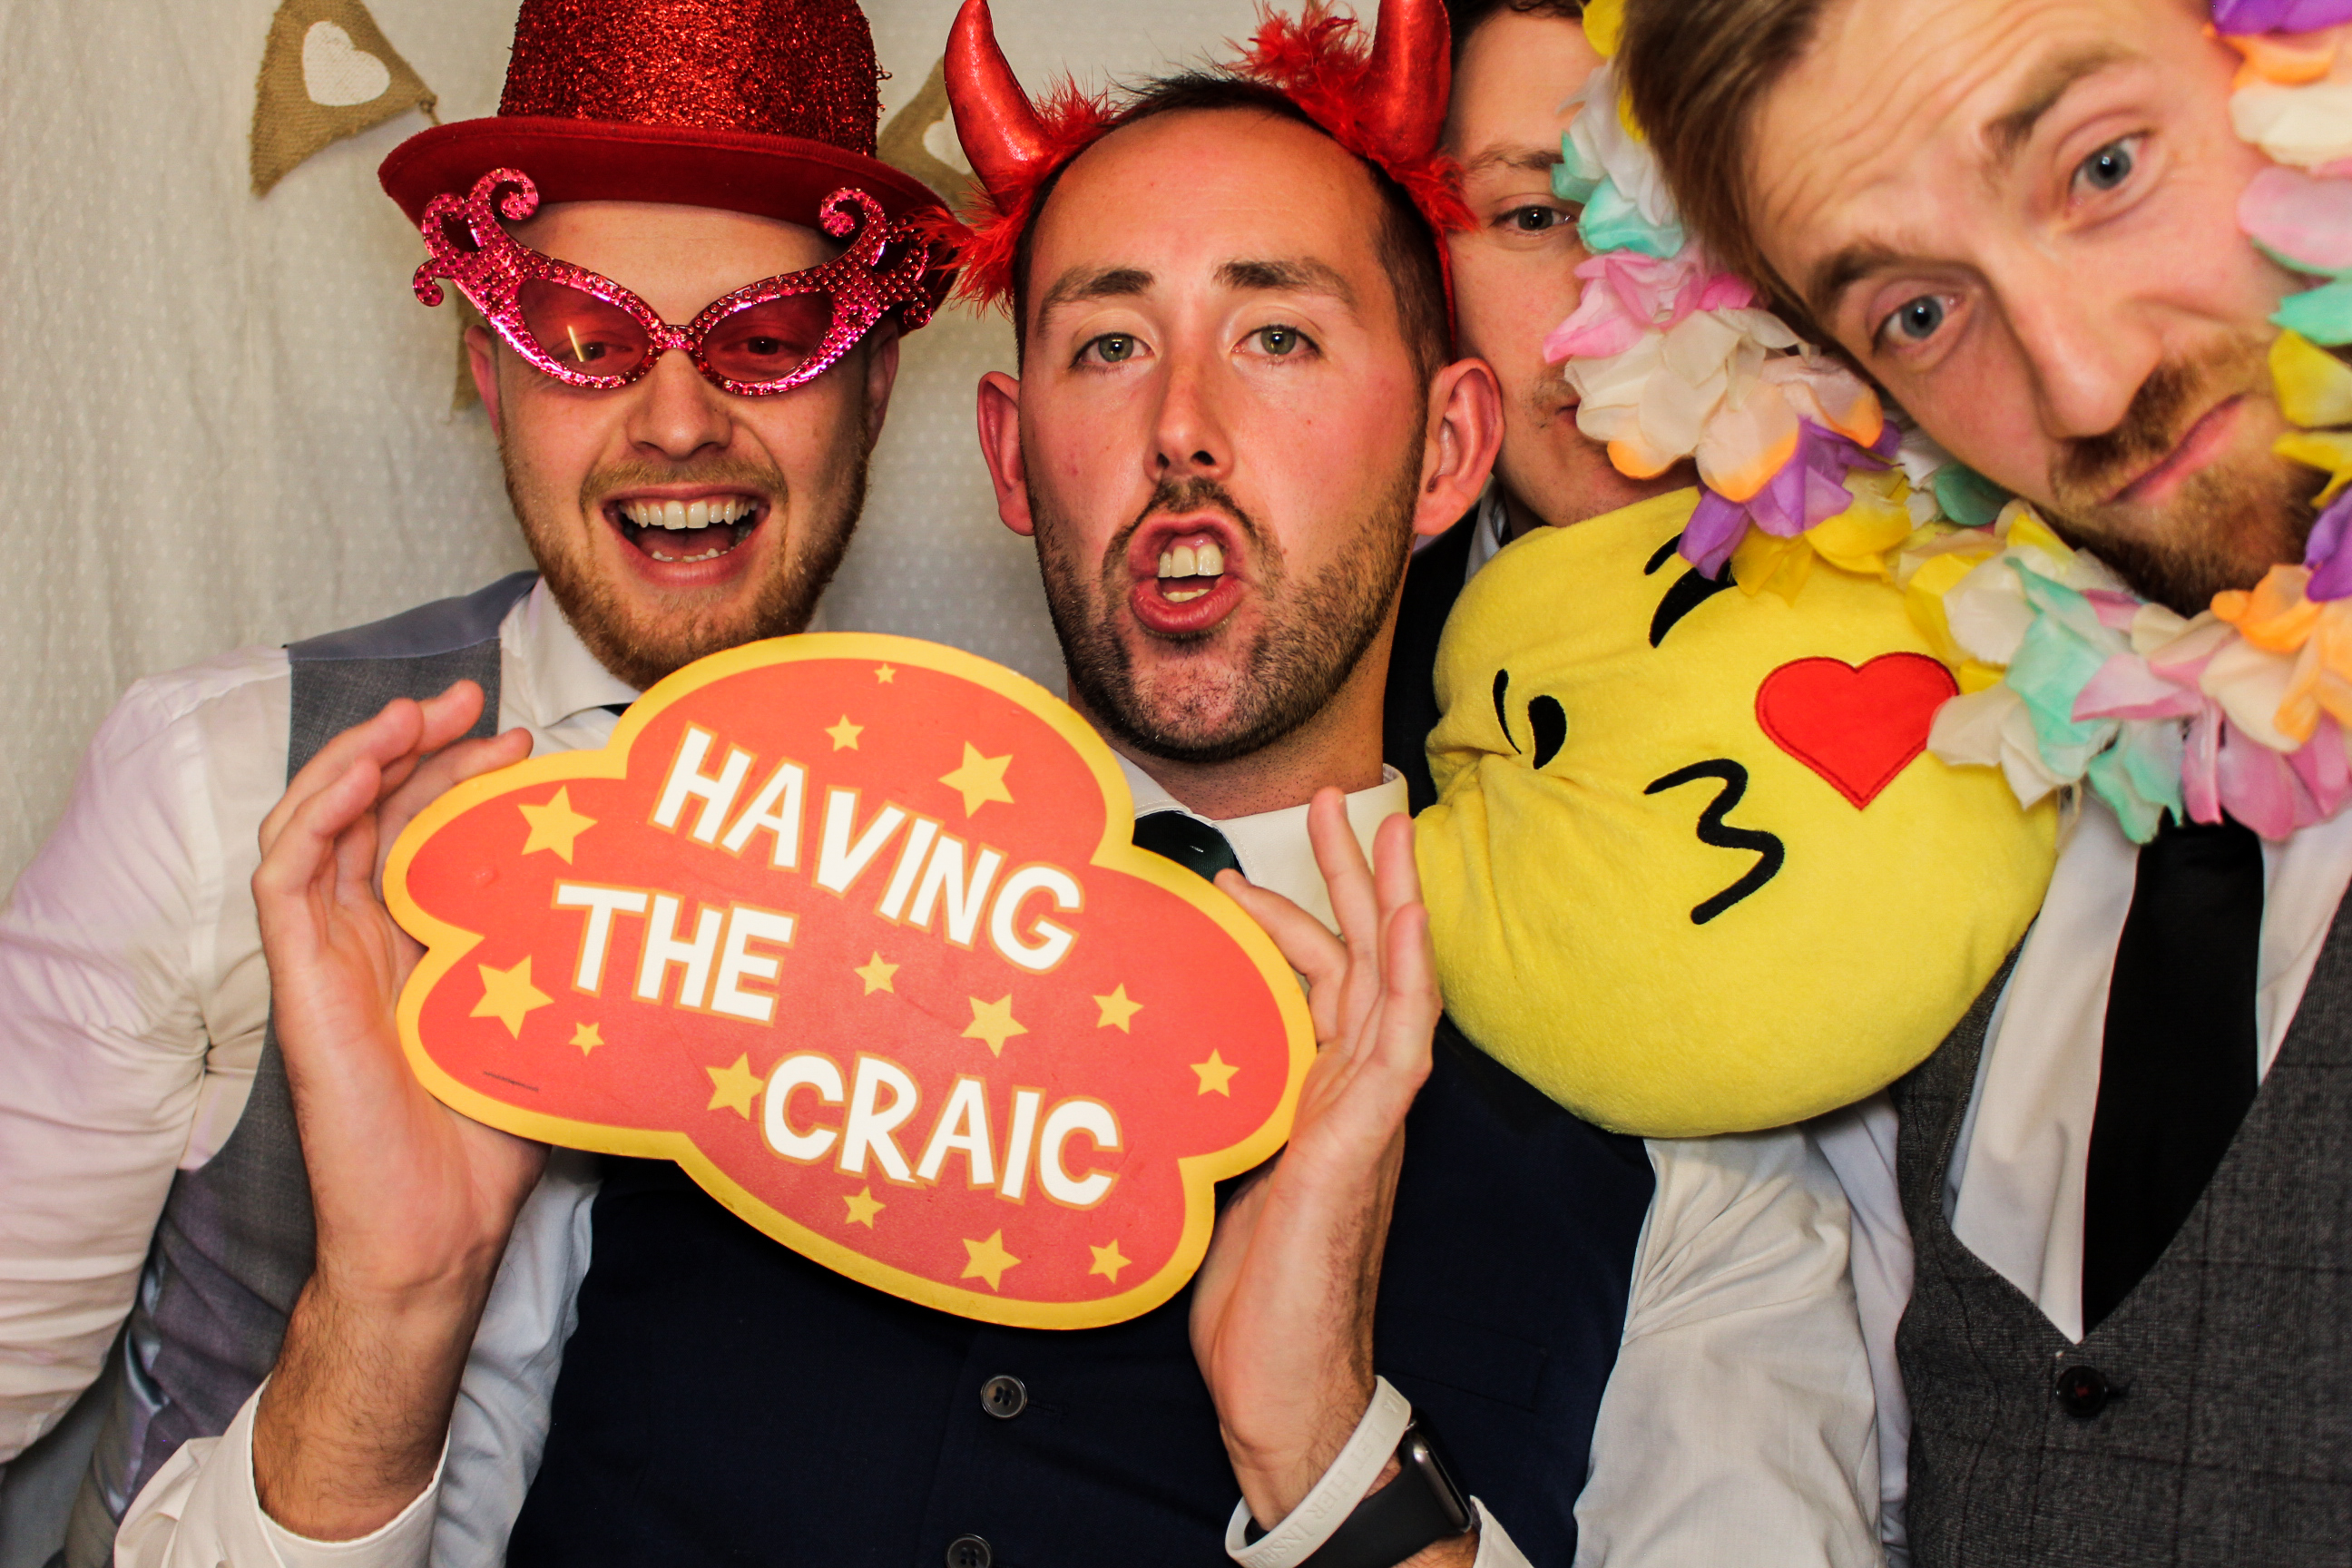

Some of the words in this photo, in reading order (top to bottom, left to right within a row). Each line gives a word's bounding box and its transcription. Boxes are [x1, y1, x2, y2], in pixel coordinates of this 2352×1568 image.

[652, 726, 1082, 972] HAVING
[556, 883, 796, 1023] THE
[763, 1054, 1119, 1207] CRAIC
[1307, 1468, 1359, 1519] HER
